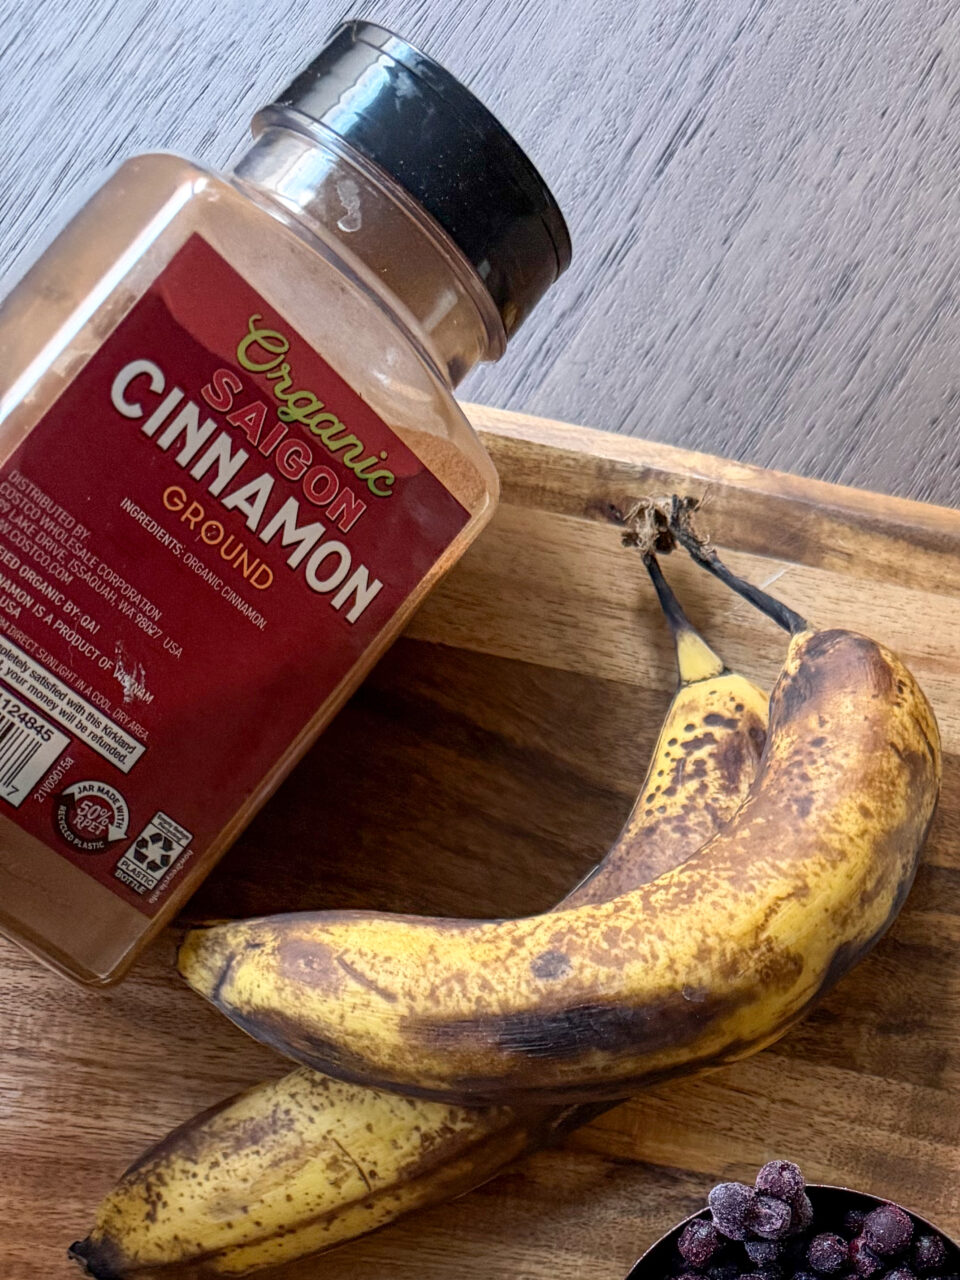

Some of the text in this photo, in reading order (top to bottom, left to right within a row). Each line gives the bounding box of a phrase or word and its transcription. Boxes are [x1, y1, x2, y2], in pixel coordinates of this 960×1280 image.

[236, 314, 396, 498] Organic
[201, 368, 368, 531] SAIGON
[7, 469, 76, 529] DISTRIBUTED
[109, 357, 384, 627] CINNAMON
[0, 481, 162, 621] COSTCO WHOLESALE CORPORATION
[119, 497, 269, 631] INGREDIENTS: ORGANIC CINNAMON.
[161, 485, 275, 591] GROUND
[0, 596, 21, 619] USA
[7, 509, 37, 536] LAKE
[66, 558, 119, 605] ISSAQUAH,
[117, 600, 135, 617] WA
[132, 613, 162, 640] 98027
[162, 637, 184, 658] USA
[18, 564, 65, 606] ORGANIC
[62, 600, 82, 619] BY:
[78, 614, 100, 635] QAI
[31, 603, 46, 617] IS
[43, 612, 55, 624] A
[53, 619, 100, 660] PRODUCT
[97, 656, 113, 671] OF
[7, 625, 38, 653] DIRECT
[35, 647, 77, 683] SUNLIGHT
[75, 678, 86, 689] IN
[83, 685, 93, 695] A
[112, 708, 129, 724] DRY
[0, 693, 54, 742] 124845
[4, 666, 28, 687] your
[25, 682, 60, 712] money
[57, 706, 77, 724] will
[74, 719, 89, 733] be
[86, 728, 129, 765] refunded.
[28, 666, 69, 702] satisfied
[65, 696, 87, 716] with
[84, 711, 103, 729] this
[100, 723, 136, 754] Kirkland
[6, 784, 19, 796] 7
[77, 784, 125, 829] JAR MADE WITH
[77, 800, 112, 826] 50%
[57, 804, 105, 850] RECYCLED PLASTIC
[73, 815, 106, 835] RPET
[115, 869, 148, 894] BOTTLE
[120, 860, 155, 887] PLASTIC
